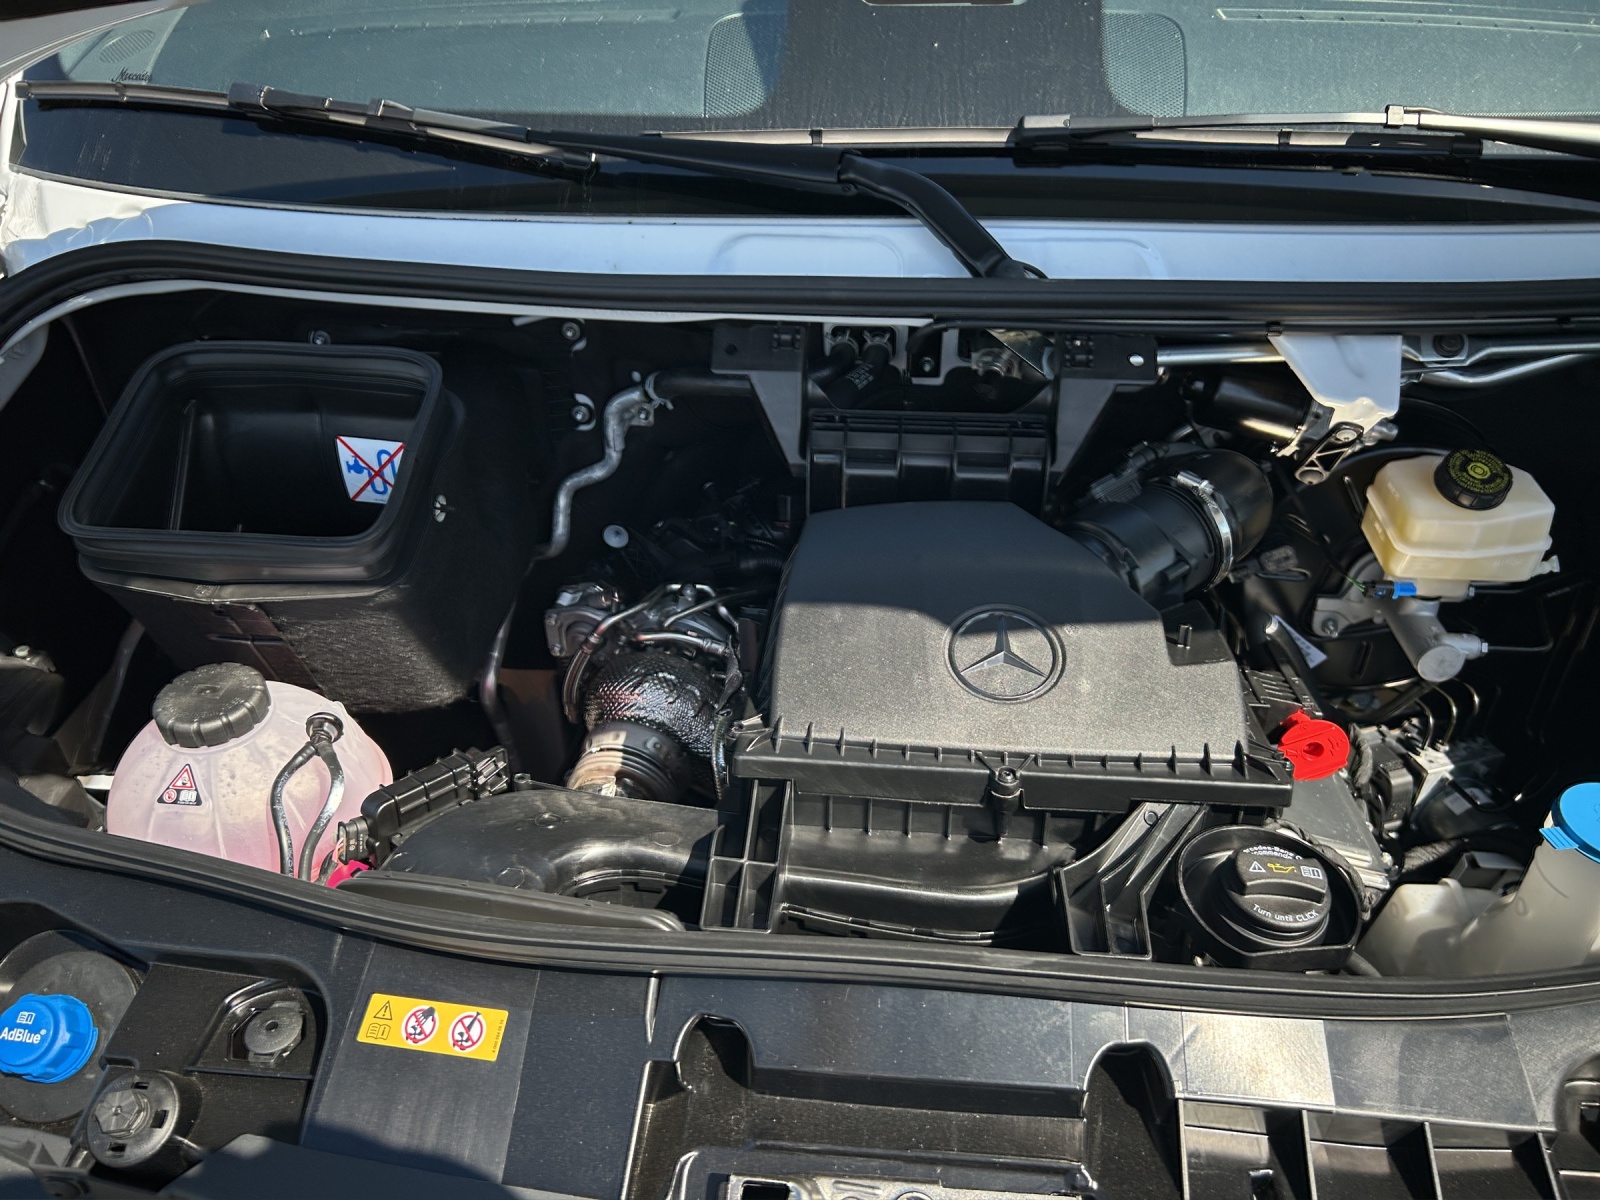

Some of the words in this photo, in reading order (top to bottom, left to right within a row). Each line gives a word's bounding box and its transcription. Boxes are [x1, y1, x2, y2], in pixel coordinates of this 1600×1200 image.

[1253, 904, 1272, 918] Turn
[1274, 913, 1293, 922] until
[1295, 910, 1319, 922] CLICK
